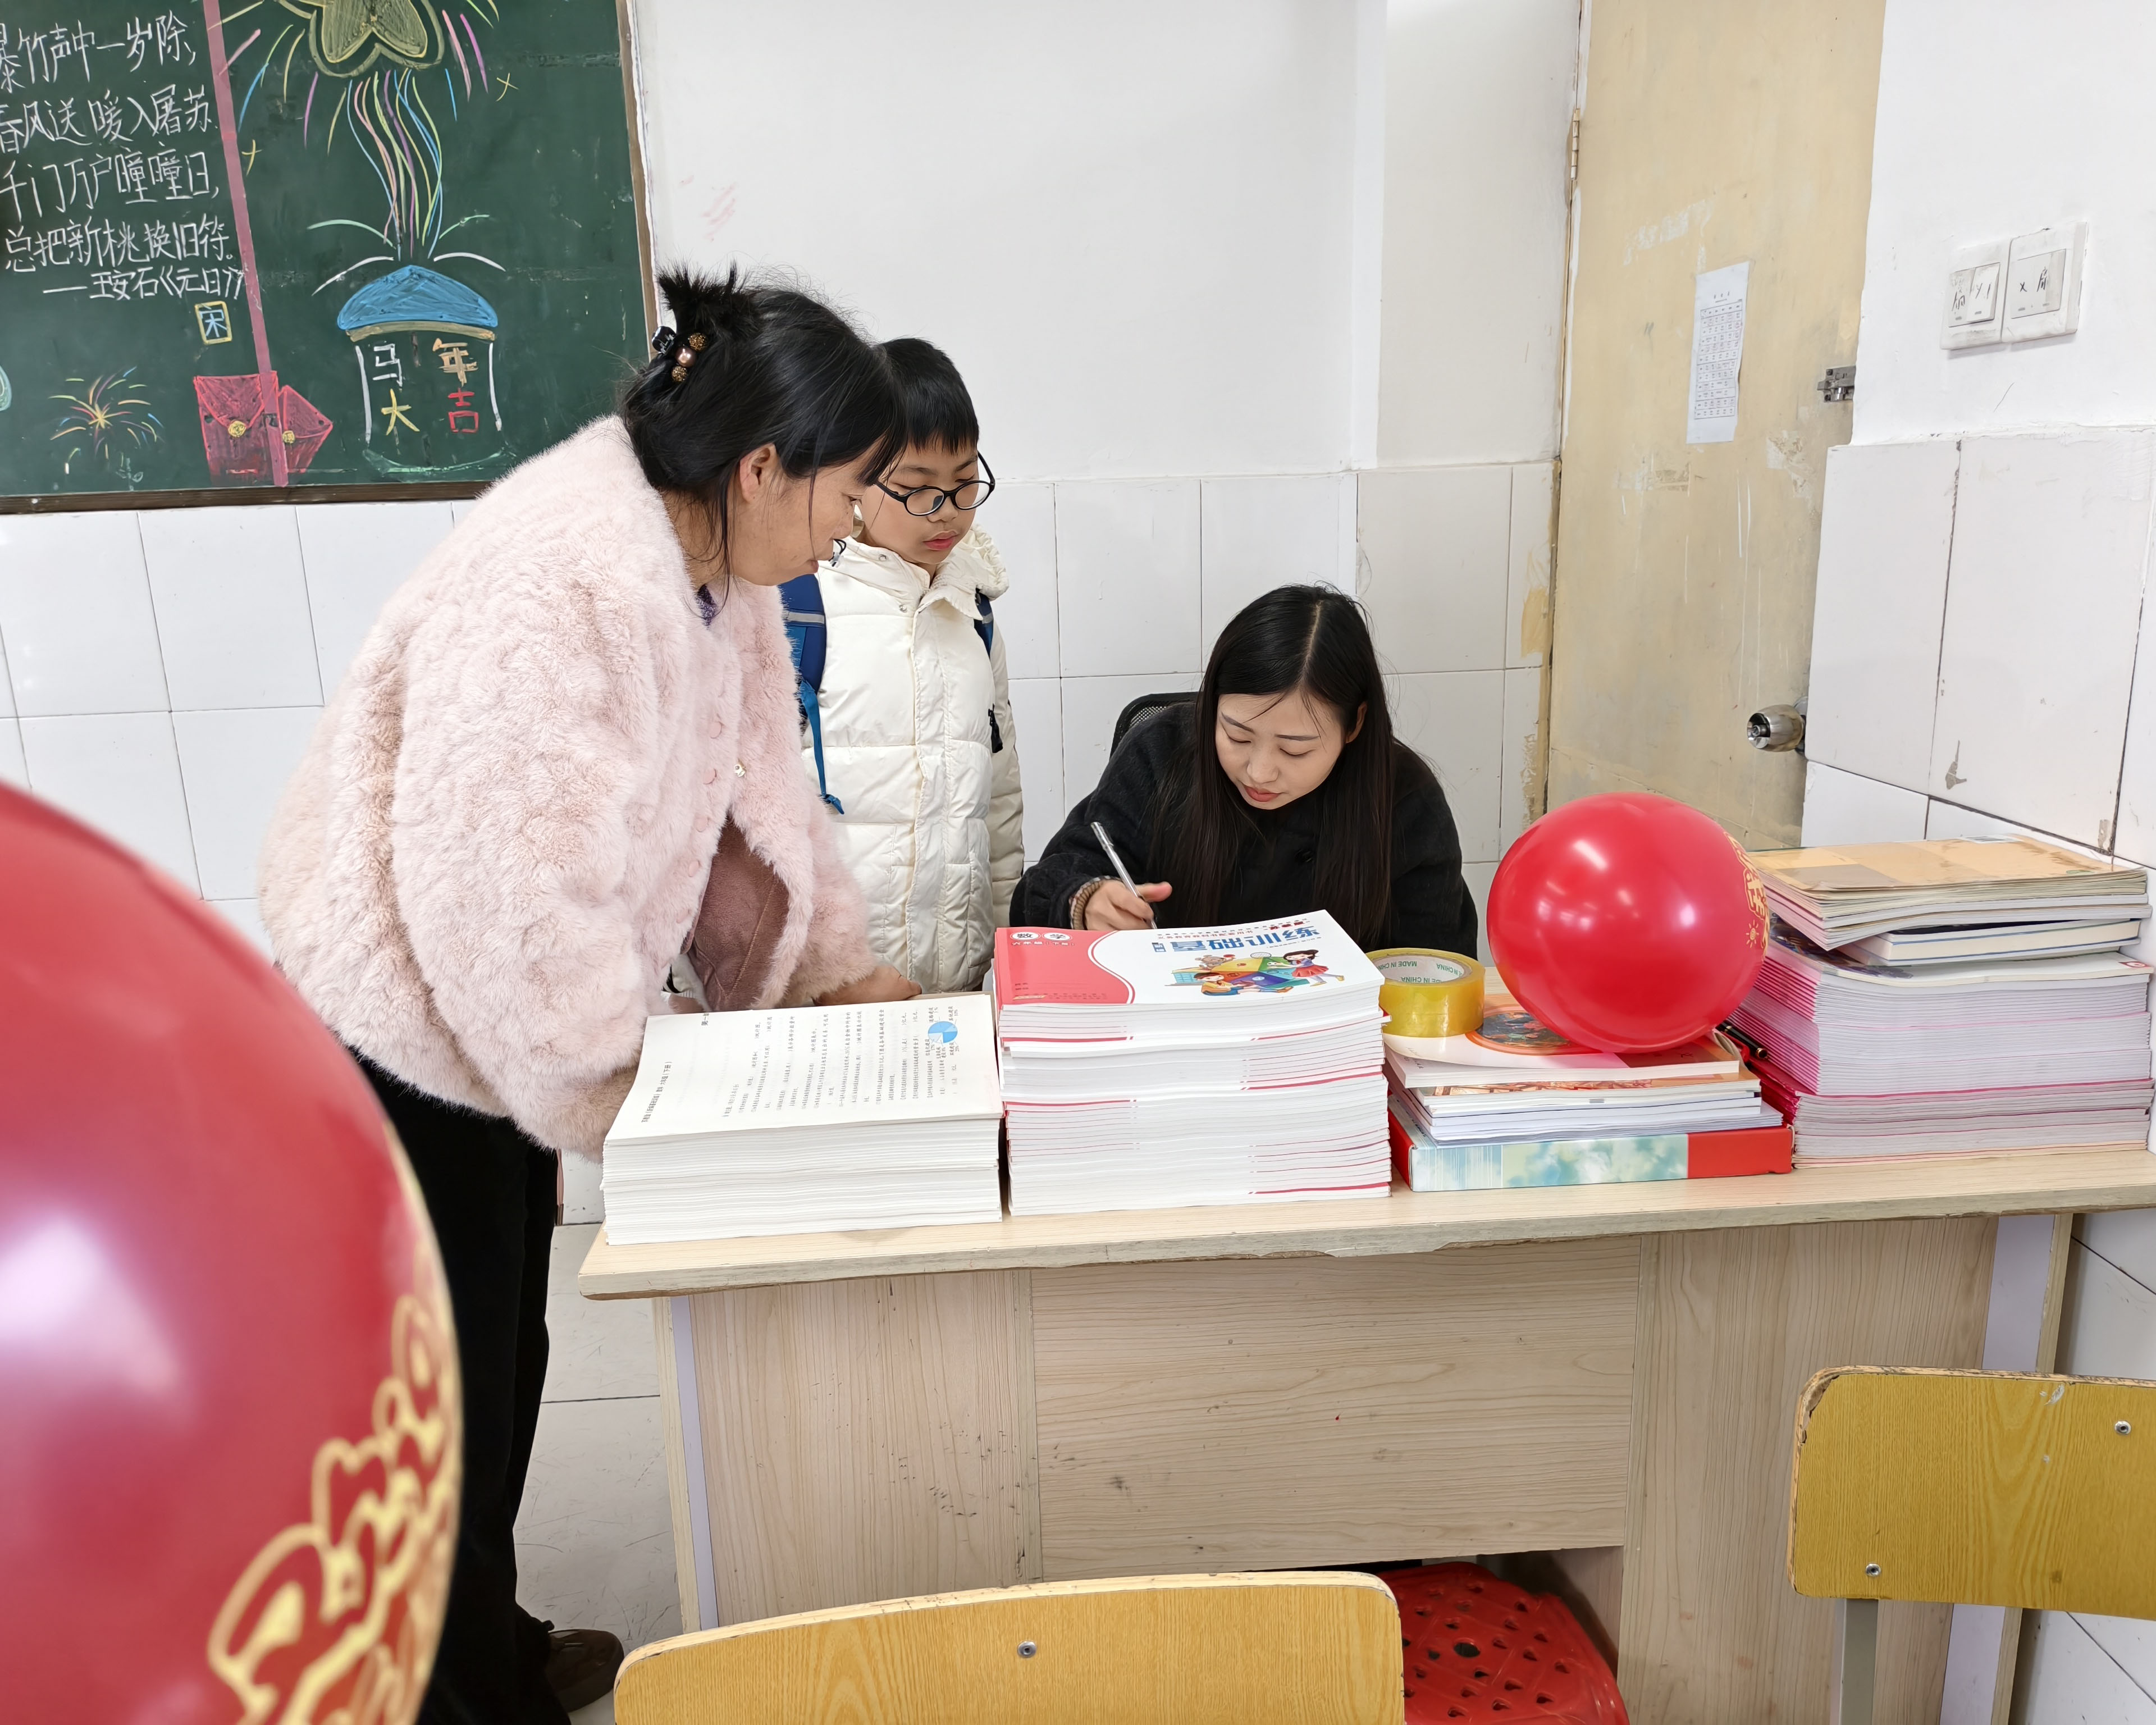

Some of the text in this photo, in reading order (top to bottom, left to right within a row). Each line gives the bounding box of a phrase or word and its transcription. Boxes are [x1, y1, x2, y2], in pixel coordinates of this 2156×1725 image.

[1170, 925, 1320, 952] 基础训练
[1437, 963, 1454, 973] CHINA
